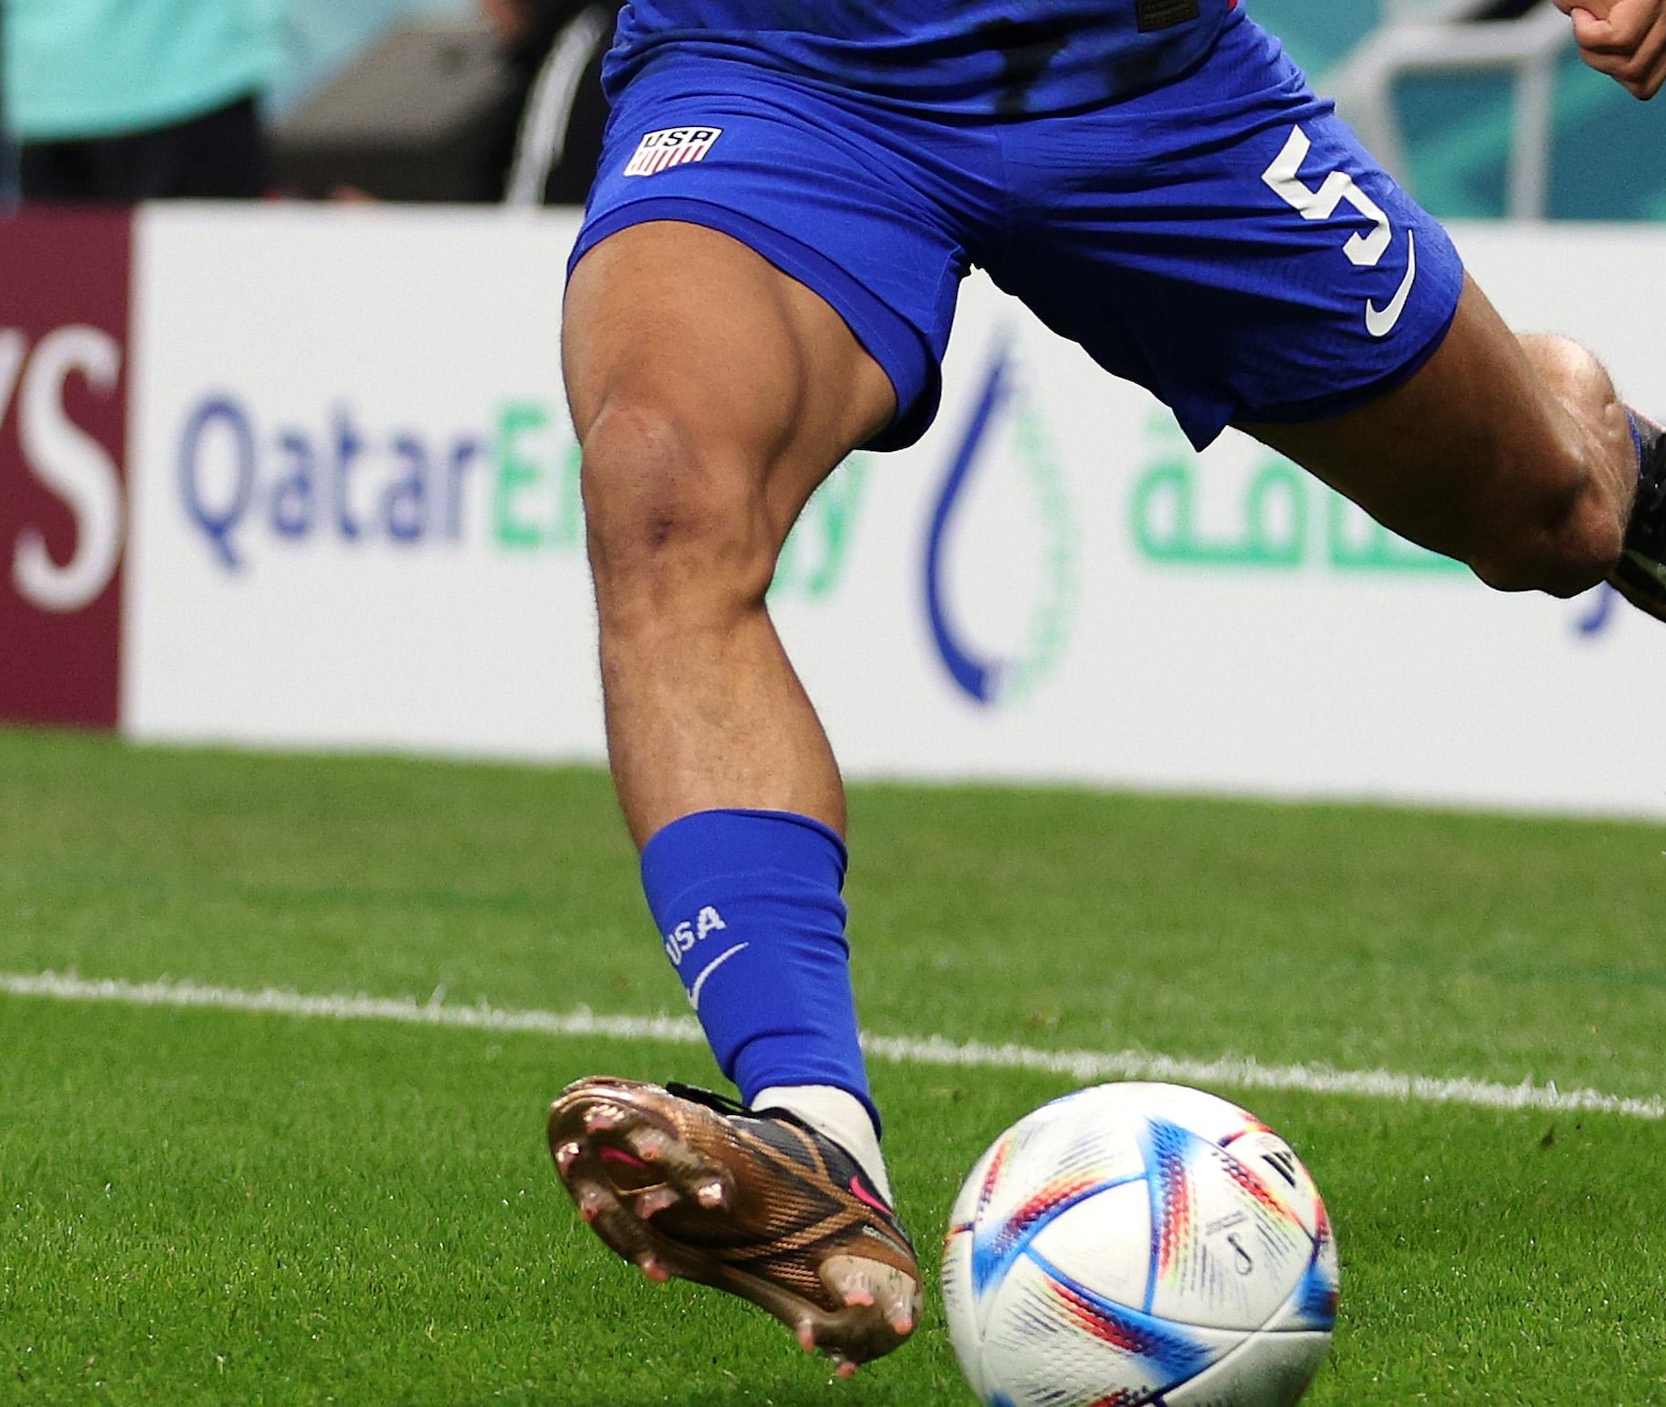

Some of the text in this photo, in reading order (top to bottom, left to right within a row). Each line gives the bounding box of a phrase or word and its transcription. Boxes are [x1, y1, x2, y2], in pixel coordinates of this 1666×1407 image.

[644, 130, 714, 148] USA
[1261, 123, 1392, 266] 5
[665, 905, 727, 966] USA
